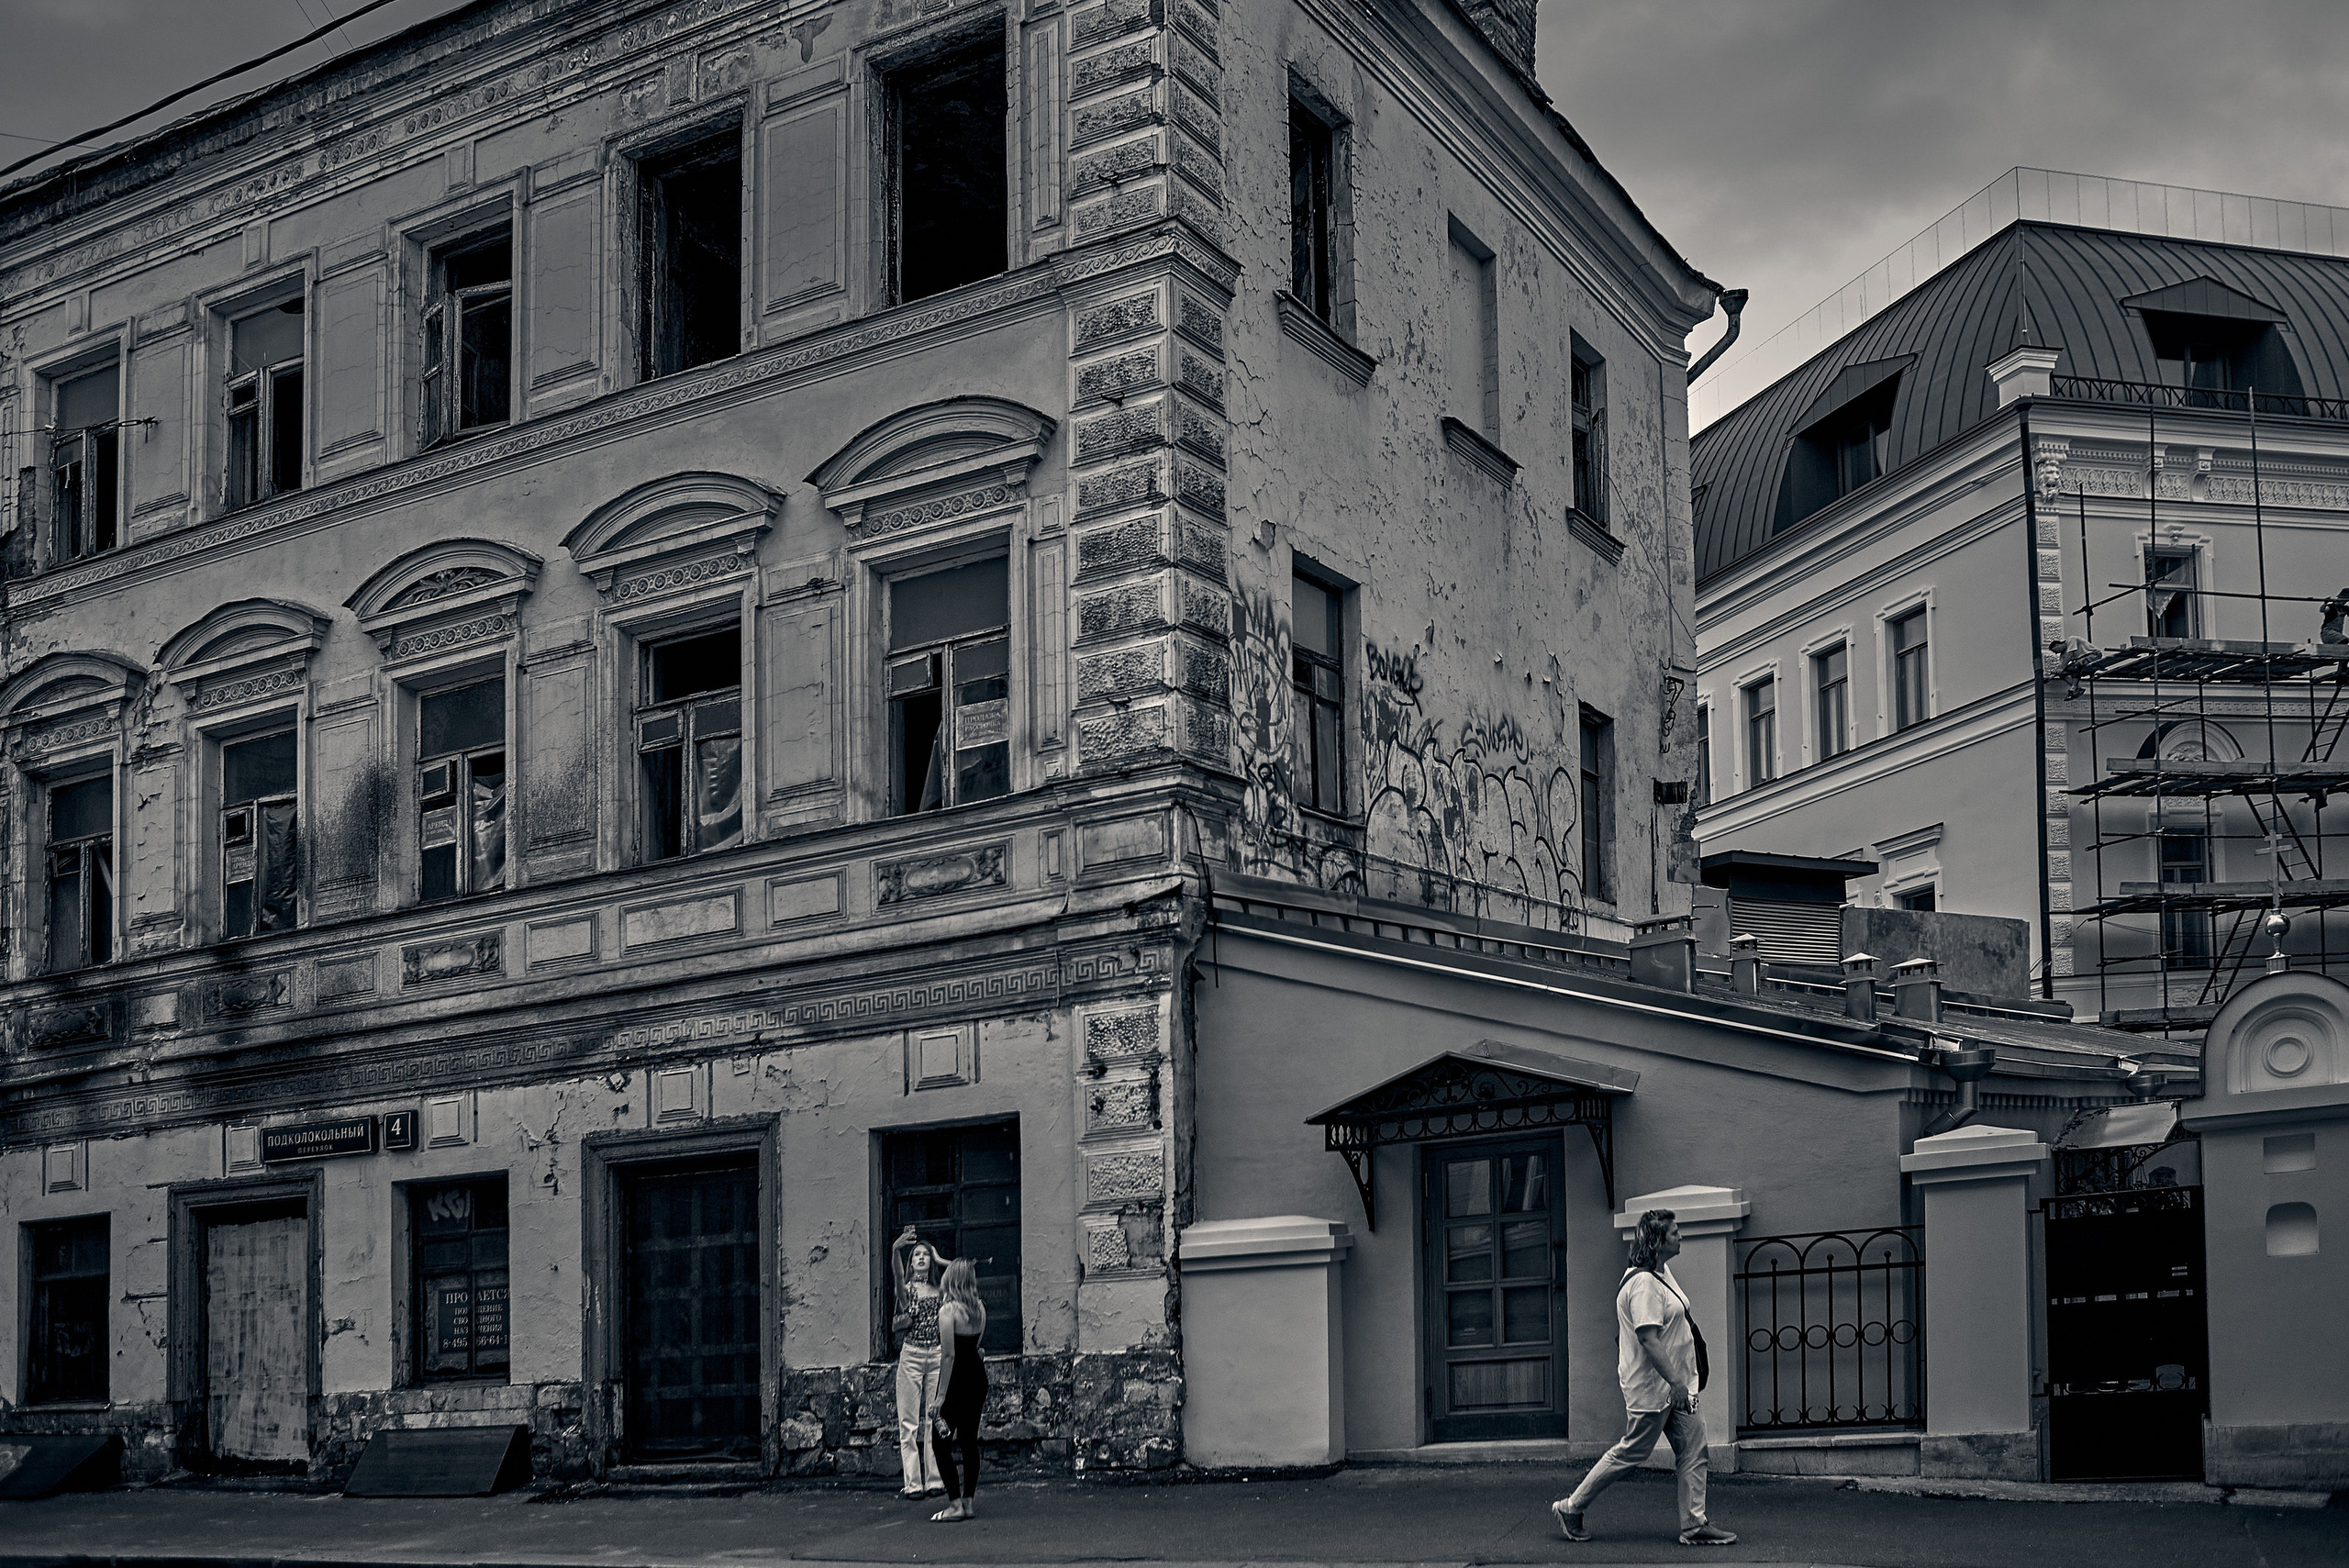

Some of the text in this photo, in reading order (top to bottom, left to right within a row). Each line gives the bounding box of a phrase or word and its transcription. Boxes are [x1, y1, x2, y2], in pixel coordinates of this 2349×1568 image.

[964, 712, 1002, 724] ПРОДАЖА
[267, 1123, 365, 1148] ПОДКОЛОКОЛЬНЫЙ
[391, 1118, 403, 1137] 4
[297, 1144, 334, 1154] ПЕРЕУЛОК
[446, 1288, 509, 1305] ПРОАЕТСЯ
